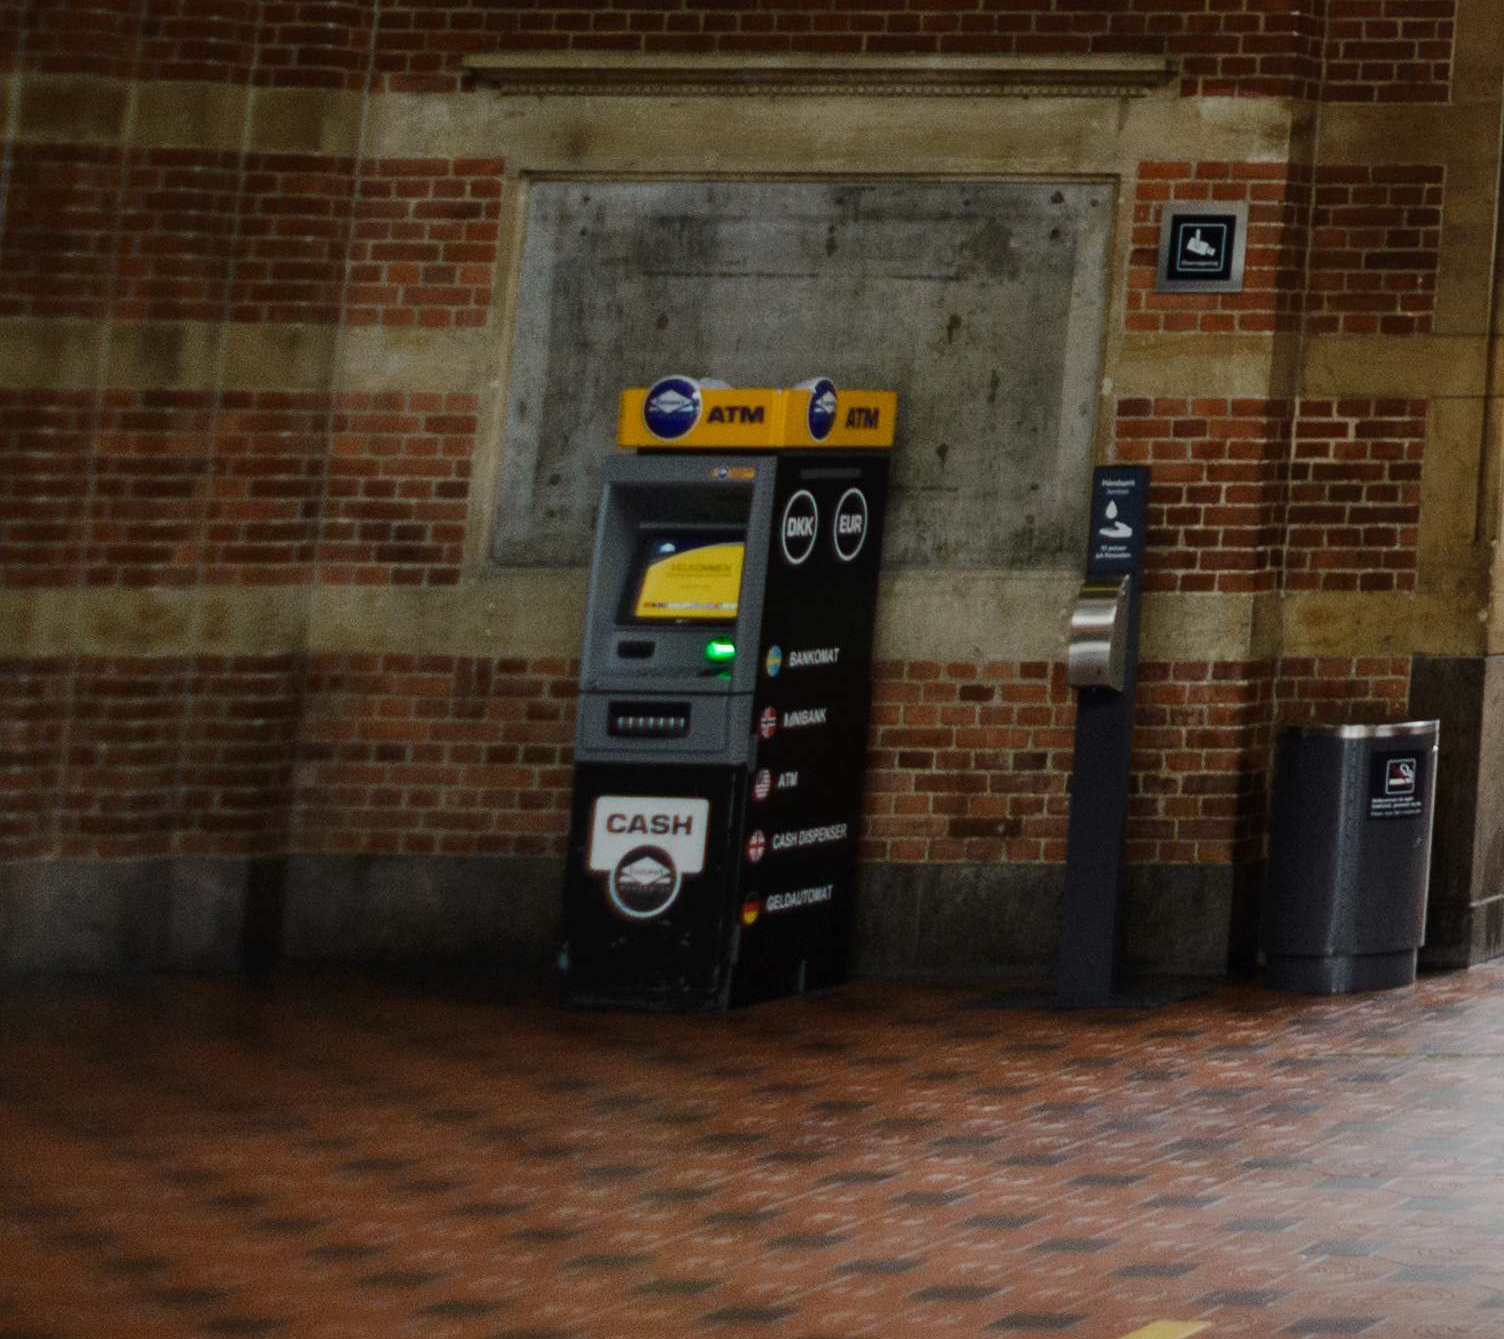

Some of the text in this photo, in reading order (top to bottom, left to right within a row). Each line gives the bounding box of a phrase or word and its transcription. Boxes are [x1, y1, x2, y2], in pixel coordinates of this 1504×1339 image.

[707, 406, 765, 423] ATM
[844, 407, 880, 431] ATM
[787, 516, 814, 537] DKK
[839, 514, 862, 534] EUR
[789, 648, 840, 667] BANKOMAT
[784, 708, 827, 727] MINIBANK
[778, 772, 798, 789] ATM
[606, 813, 693, 835] CASH
[772, 823, 848, 850] CASH DISPENSER
[766, 884, 834, 911] GELDAUTOMAT
